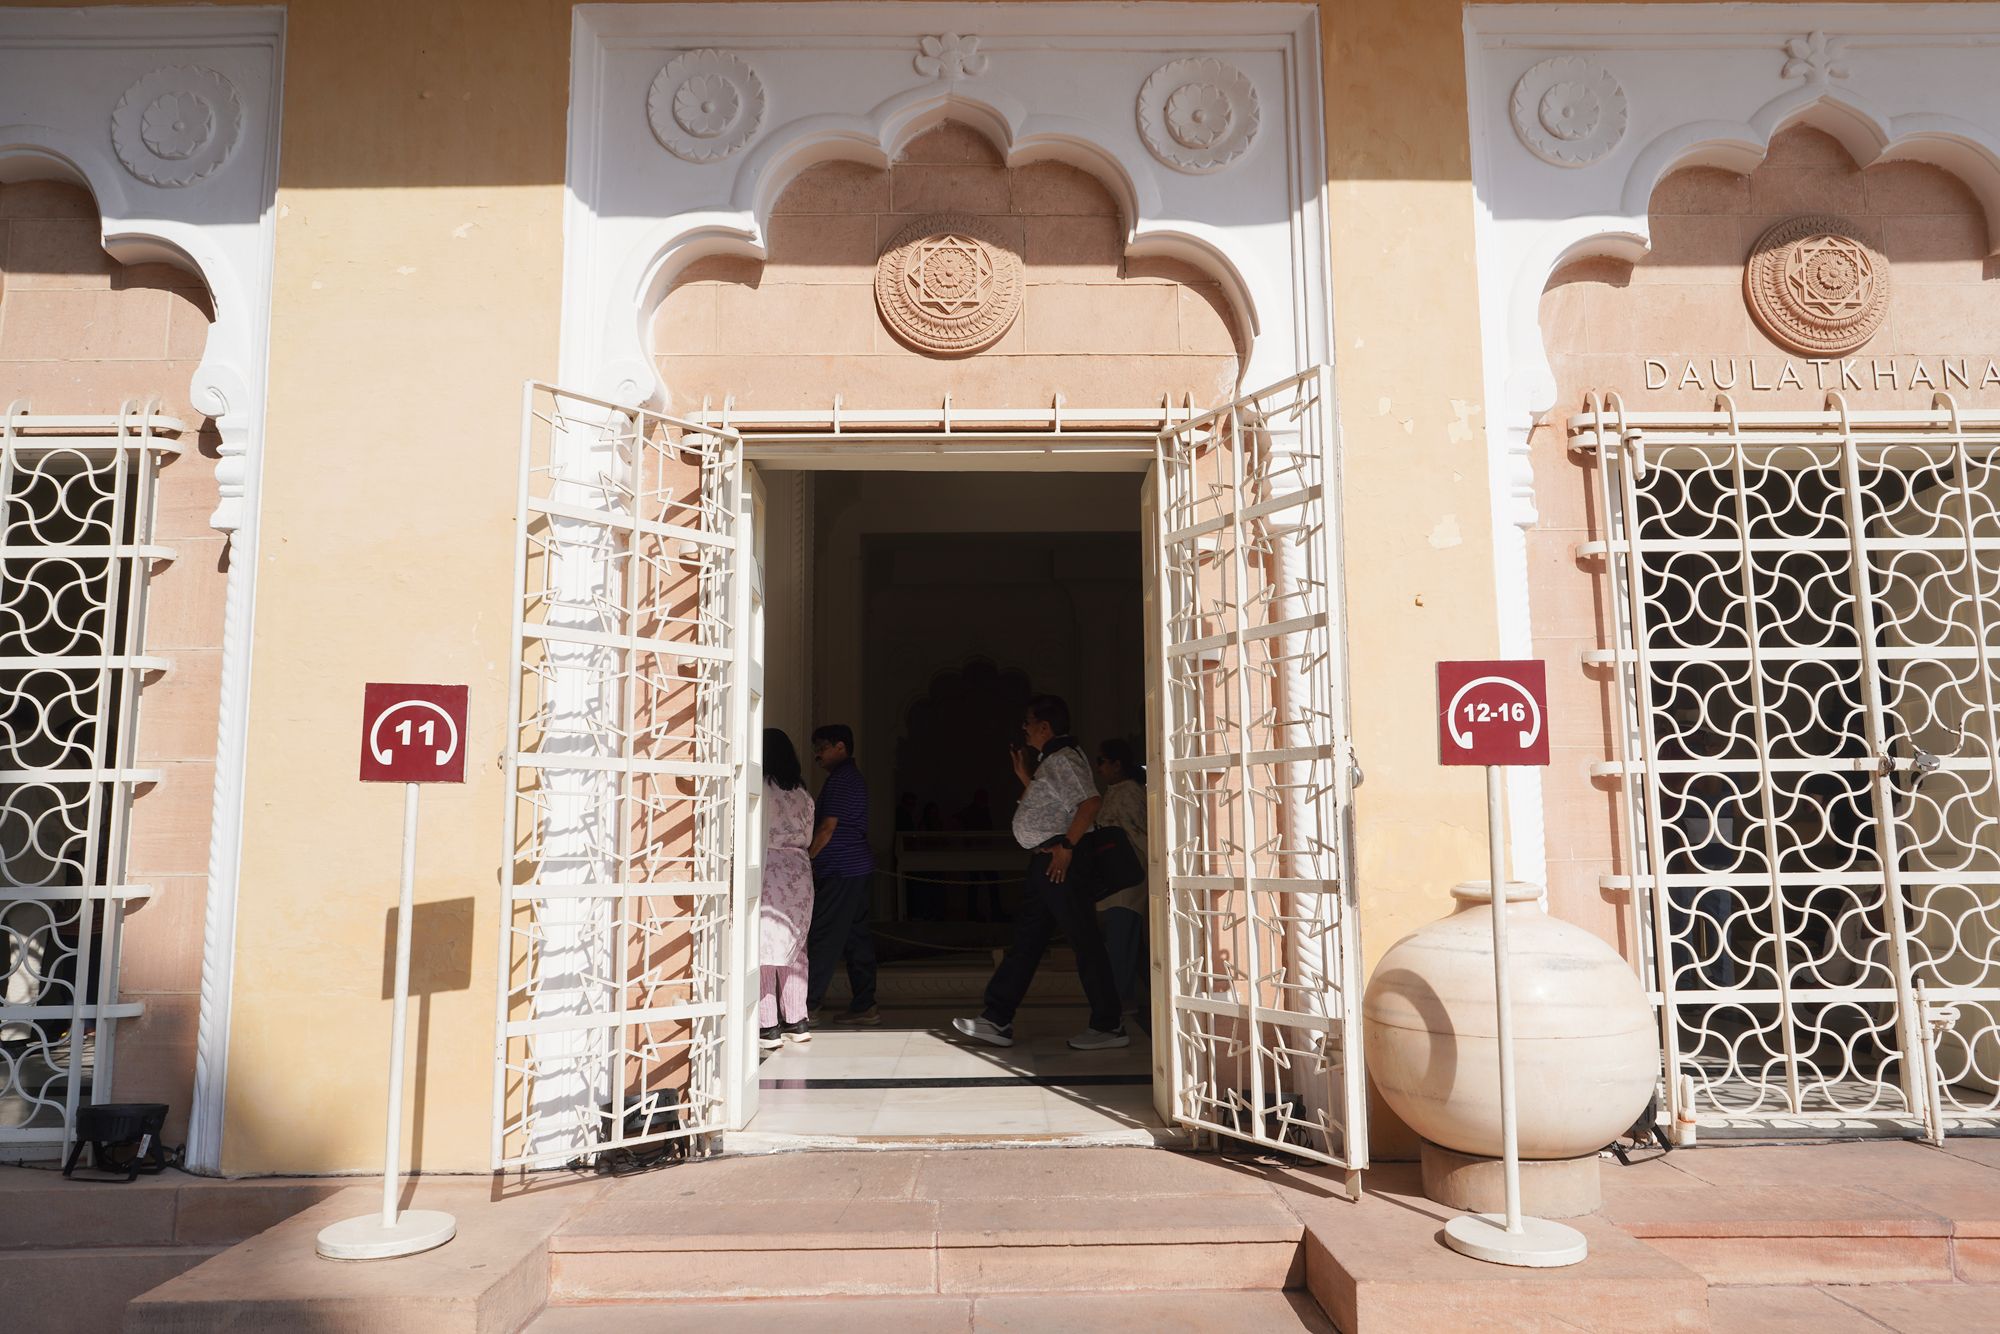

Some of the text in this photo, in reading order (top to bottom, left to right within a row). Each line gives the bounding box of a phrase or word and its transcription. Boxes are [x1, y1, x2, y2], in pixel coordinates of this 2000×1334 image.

[1644, 358, 2000, 390] DAULATKHANA
[1463, 702, 1526, 723] 12-16
[395, 719, 435, 746] 11
